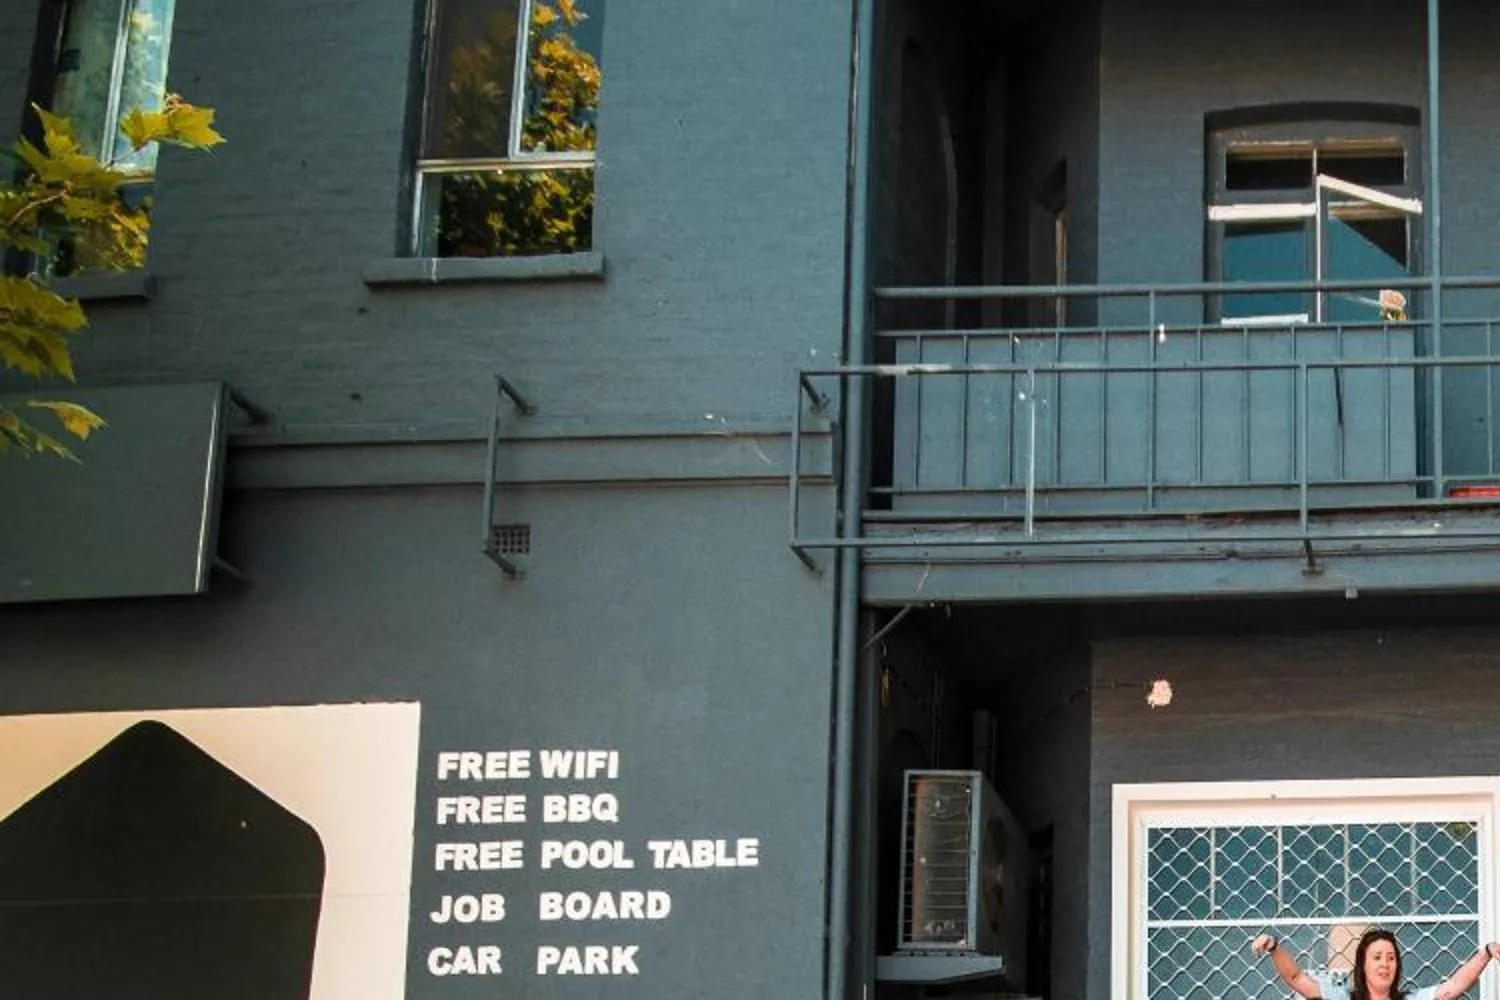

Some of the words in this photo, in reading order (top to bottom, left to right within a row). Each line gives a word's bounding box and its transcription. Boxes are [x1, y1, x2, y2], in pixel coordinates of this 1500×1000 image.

[438, 750, 531, 780] FREE
[539, 750, 619, 780] WIFI
[436, 795, 527, 825] FREE
[543, 793, 619, 823] BBQ
[435, 840, 524, 871] FREE
[541, 840, 634, 869] POOL
[647, 838, 759, 869] TABLE
[430, 893, 505, 923] JOB
[539, 890, 671, 920] BOARD
[428, 946, 502, 976] CAR
[537, 945, 639, 975] PARK
